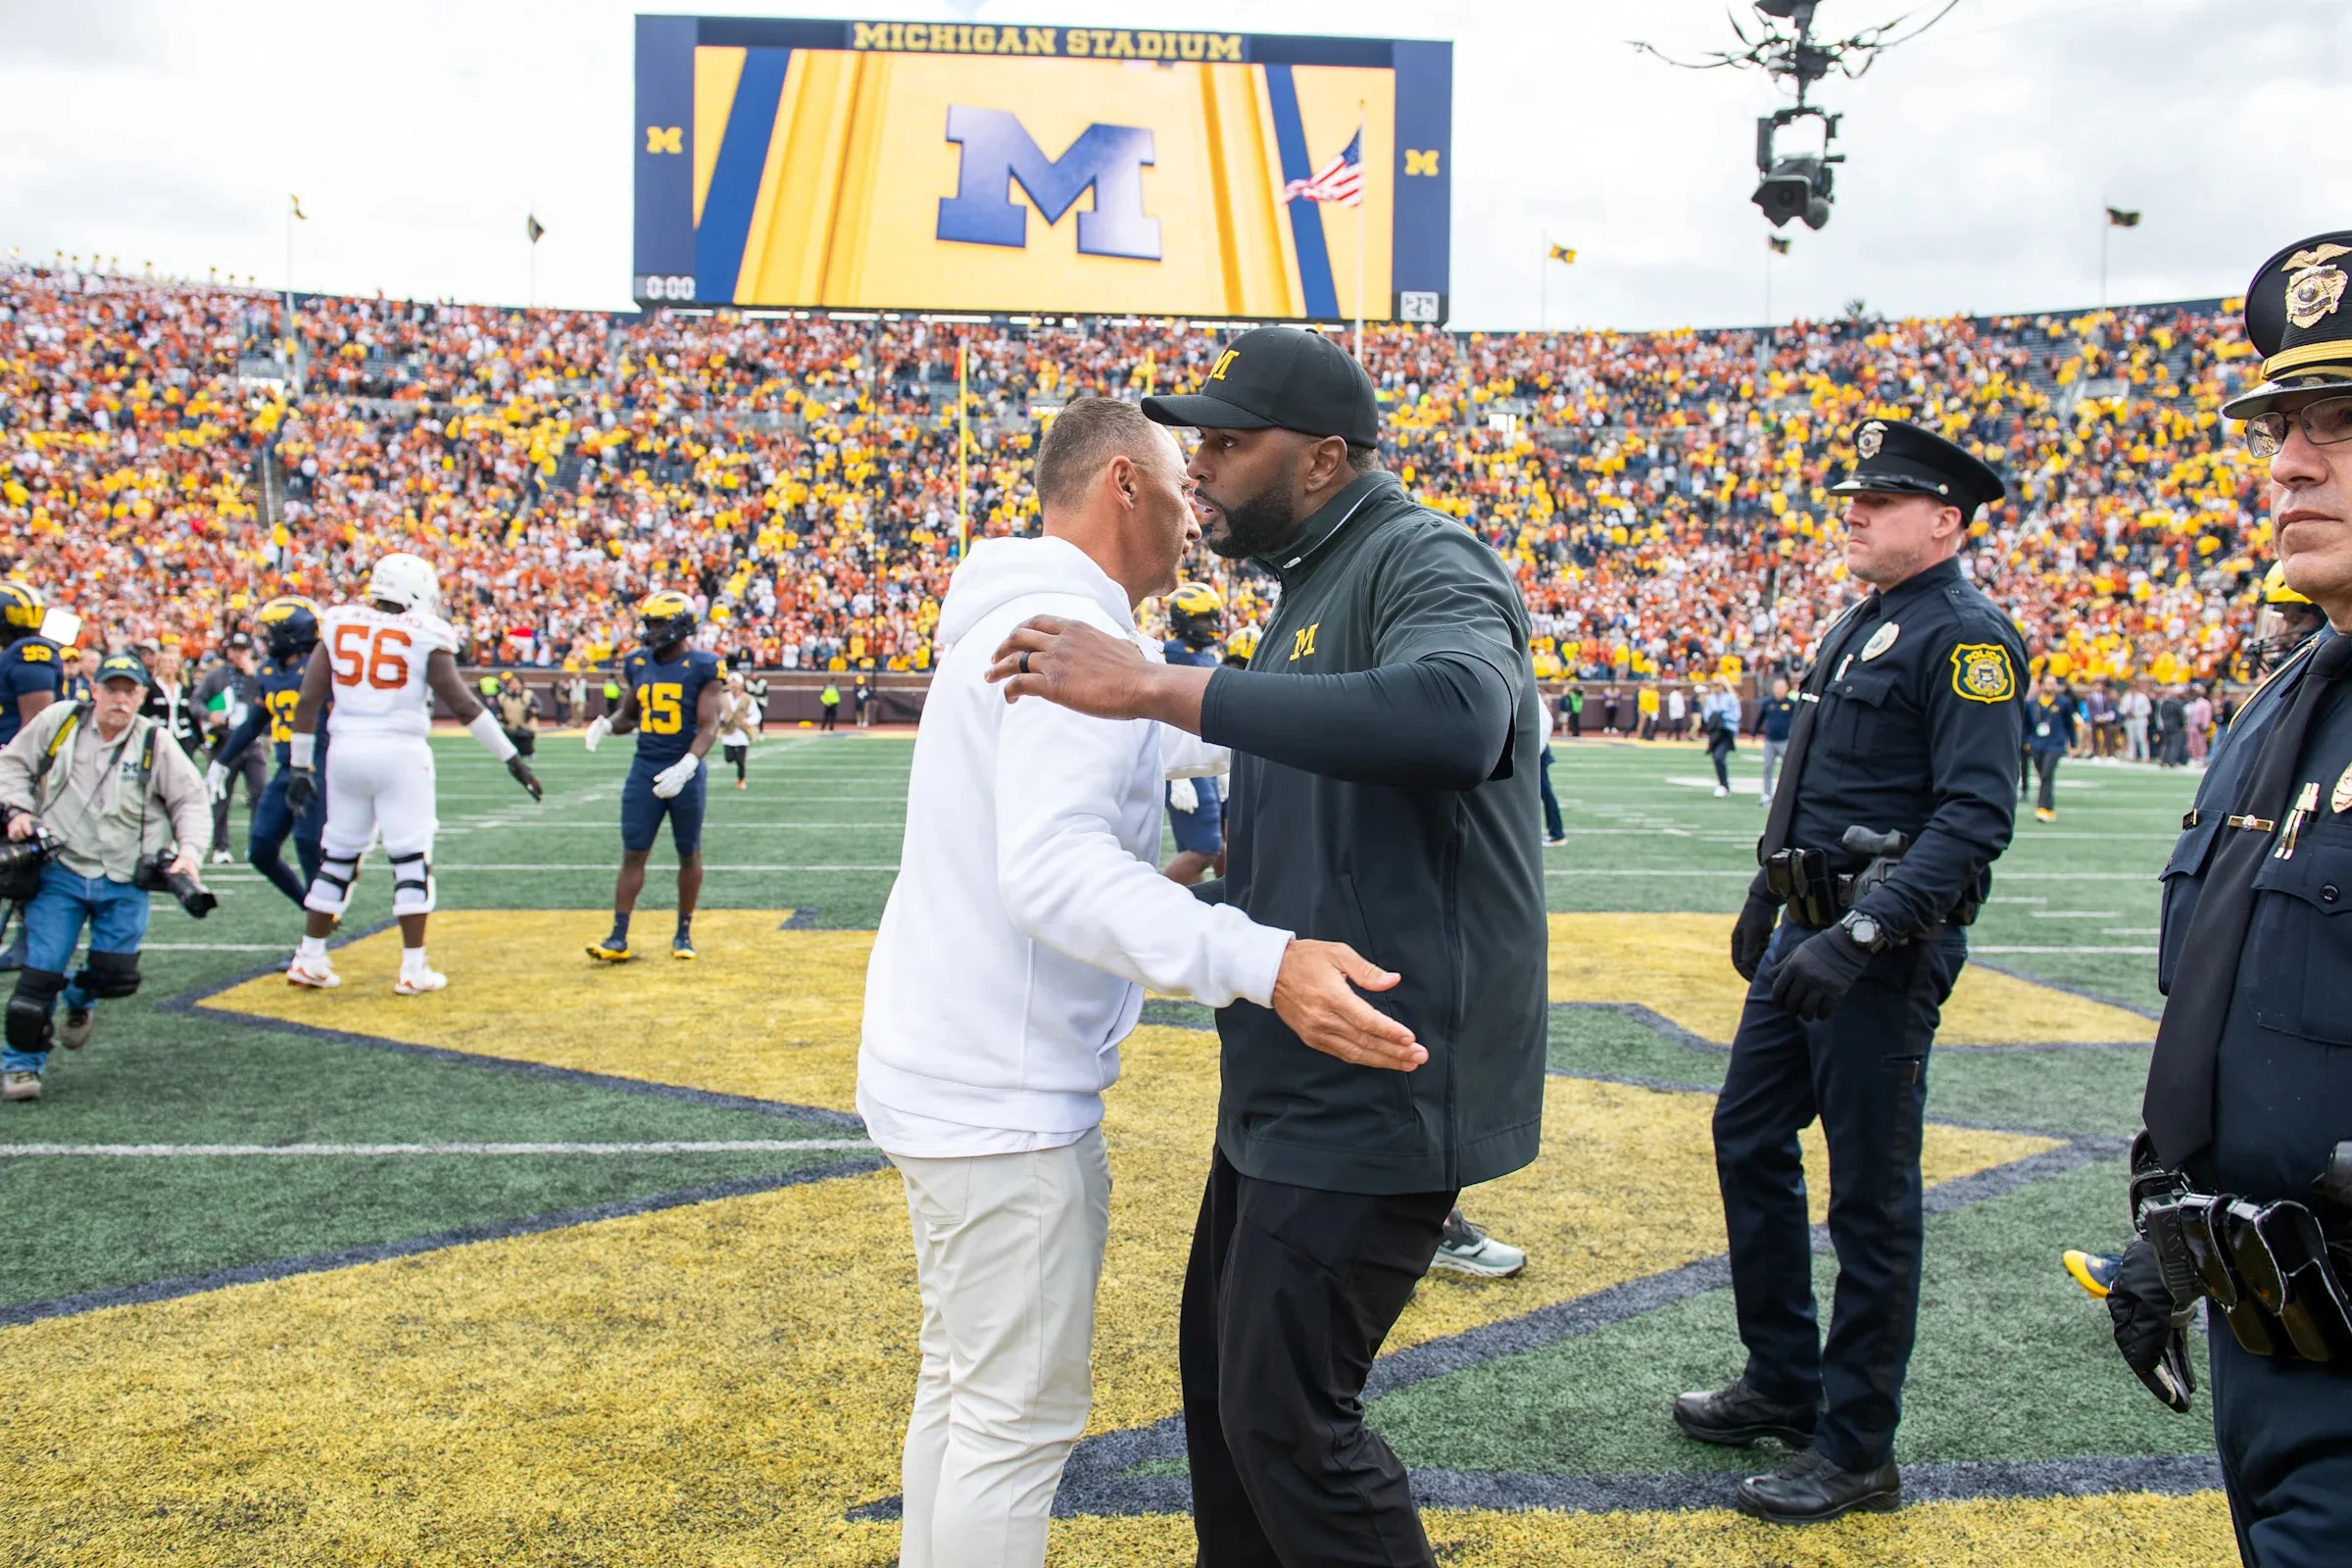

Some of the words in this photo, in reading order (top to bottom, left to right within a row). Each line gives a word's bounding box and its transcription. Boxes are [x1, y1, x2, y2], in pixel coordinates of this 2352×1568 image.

[854, 22, 1057, 56] MICHIGAN
[1066, 28, 1242, 62] STADIUM
[646, 126, 683, 154] M
[1402, 149, 1440, 176] M
[936, 104, 1161, 262] M
[334, 624, 413, 690] 56
[1289, 622, 1319, 662] M
[636, 682, 683, 735] 15
